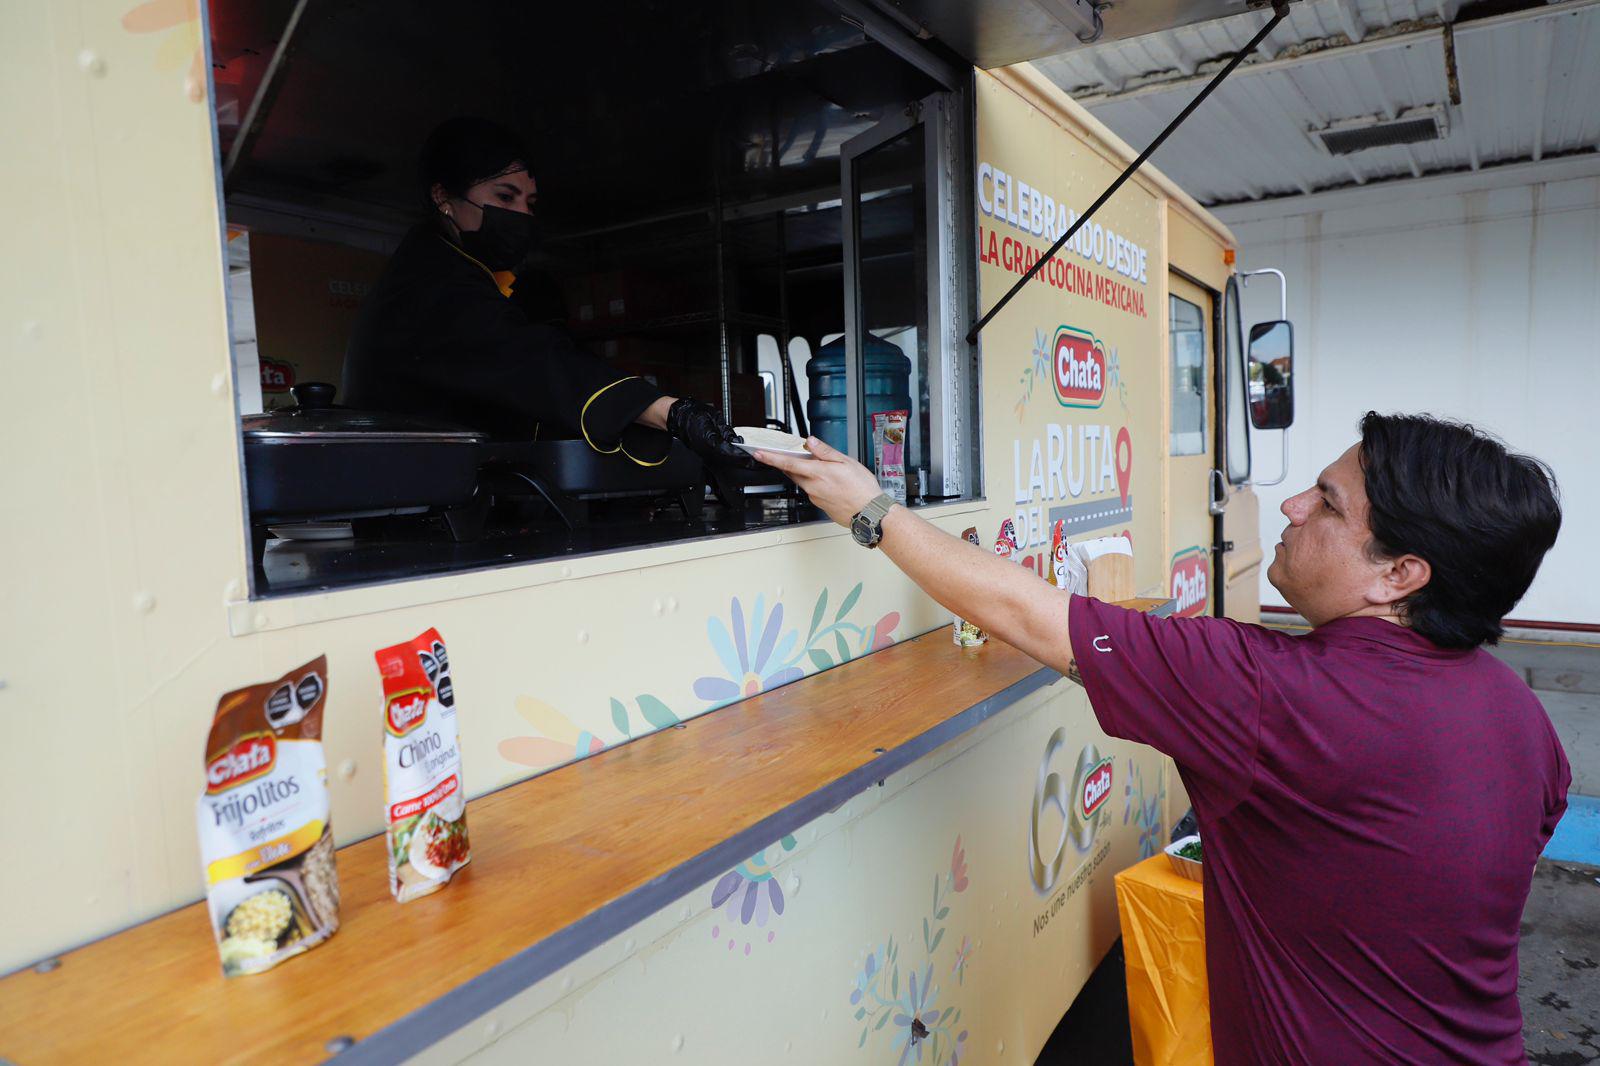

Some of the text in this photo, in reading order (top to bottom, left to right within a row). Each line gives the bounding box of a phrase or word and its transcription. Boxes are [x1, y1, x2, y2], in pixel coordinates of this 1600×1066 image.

[976, 162, 1147, 284] CELEBRANDO DESDE
[979, 226, 1148, 319] LA GRAN COCINA MEXICANA.
[1057, 345, 1102, 391] Chata
[1013, 423, 1116, 505] LA RUTA
[1015, 506, 1047, 551] DEL
[1173, 563, 1206, 613] Chata
[390, 697, 425, 729] Chata
[207, 743, 271, 784] Chata
[211, 776, 300, 826] Frijolitos
[1084, 770, 1111, 808] Chata
[1033, 910, 1049, 938] Nos
[1051, 893, 1066, 918] une
[1067, 863, 1093, 899] nuestra
